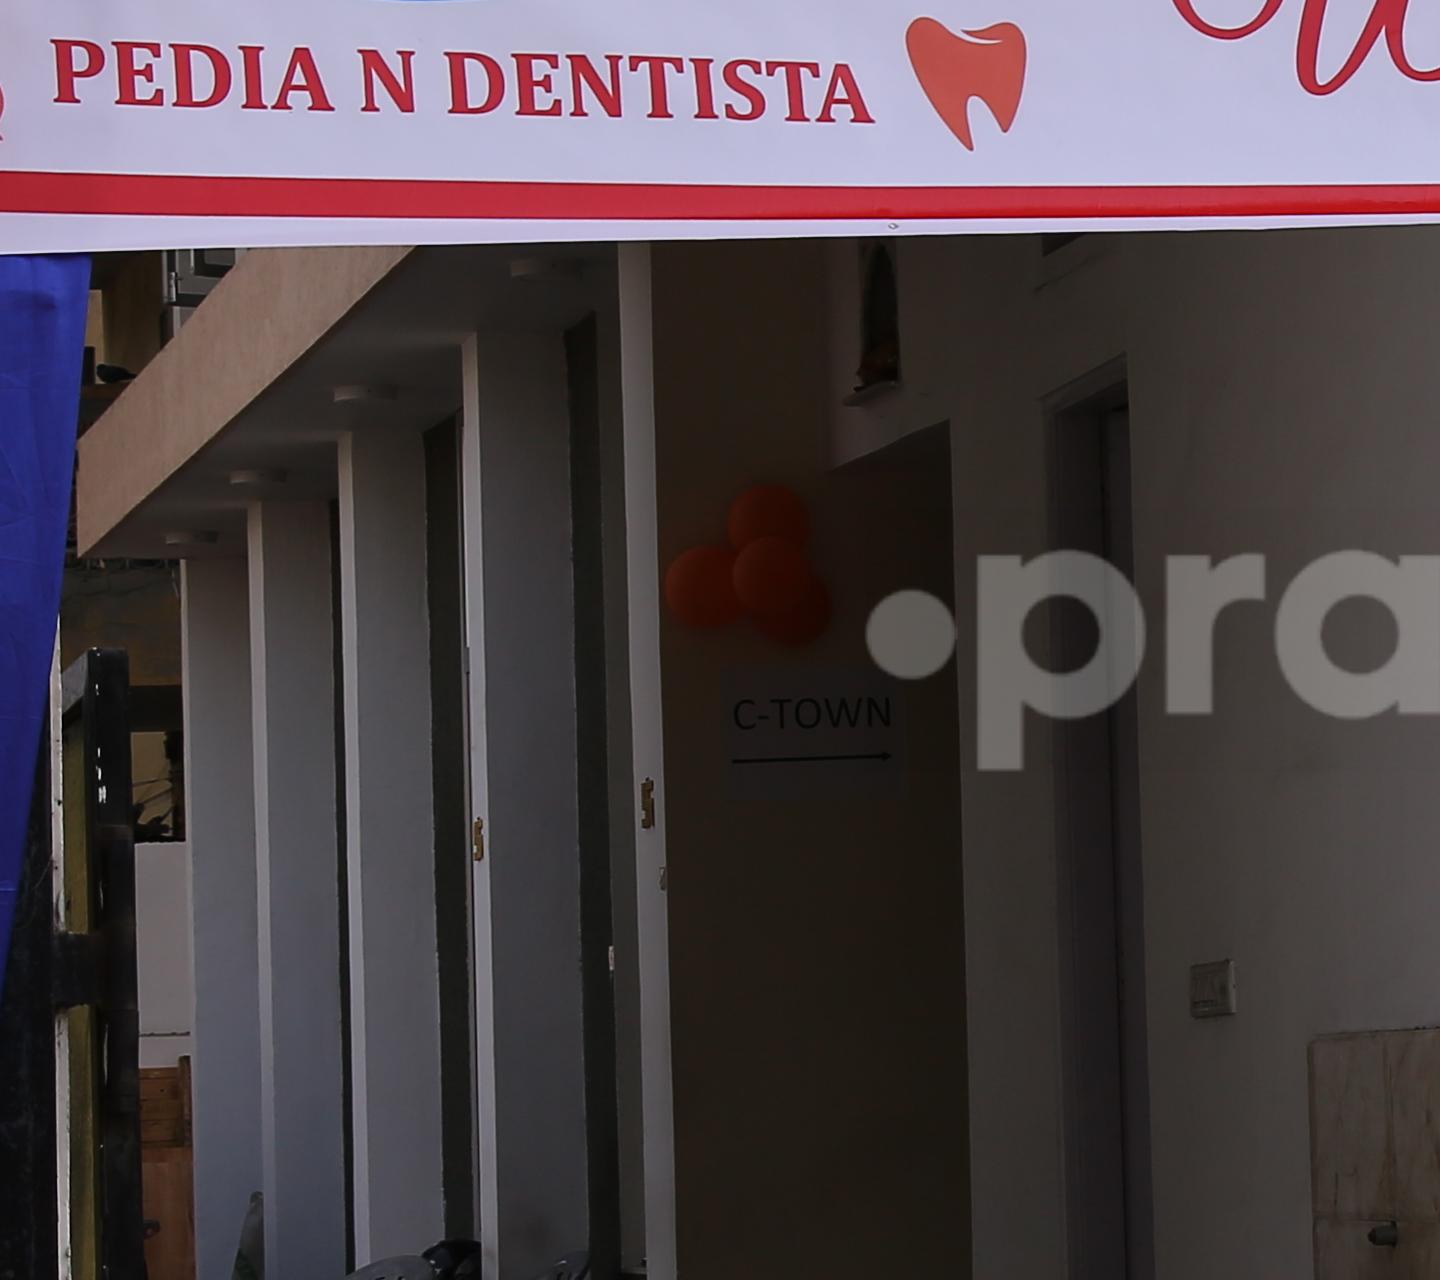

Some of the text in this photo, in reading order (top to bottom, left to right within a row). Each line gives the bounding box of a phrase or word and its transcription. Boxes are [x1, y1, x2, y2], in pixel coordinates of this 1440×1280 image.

[48, 37, 877, 125] PEDIA N DENTISTA
[733, 696, 892, 731] C-TOWN
